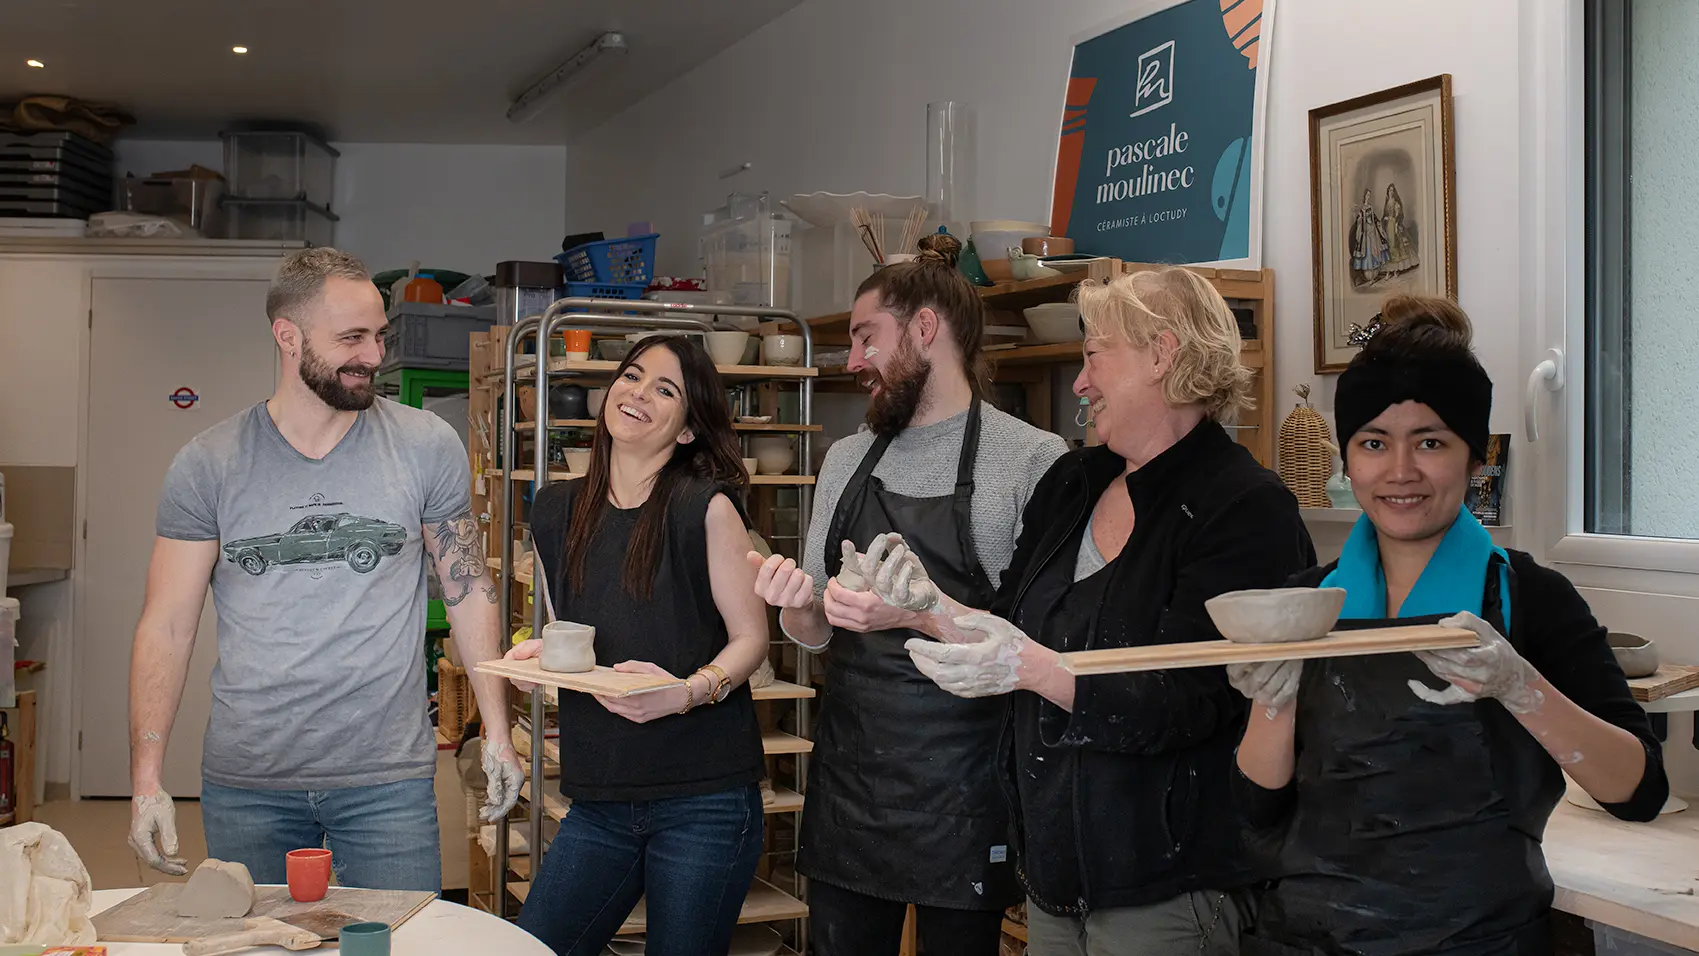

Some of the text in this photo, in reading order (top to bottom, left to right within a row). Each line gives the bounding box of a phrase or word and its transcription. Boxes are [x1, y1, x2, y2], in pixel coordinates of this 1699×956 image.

[1106, 122, 1189, 177] pascale
[1096, 164, 1195, 204] moulinec
[1096, 208, 1188, 232] CÉRAMISTE À LOCTUDY
